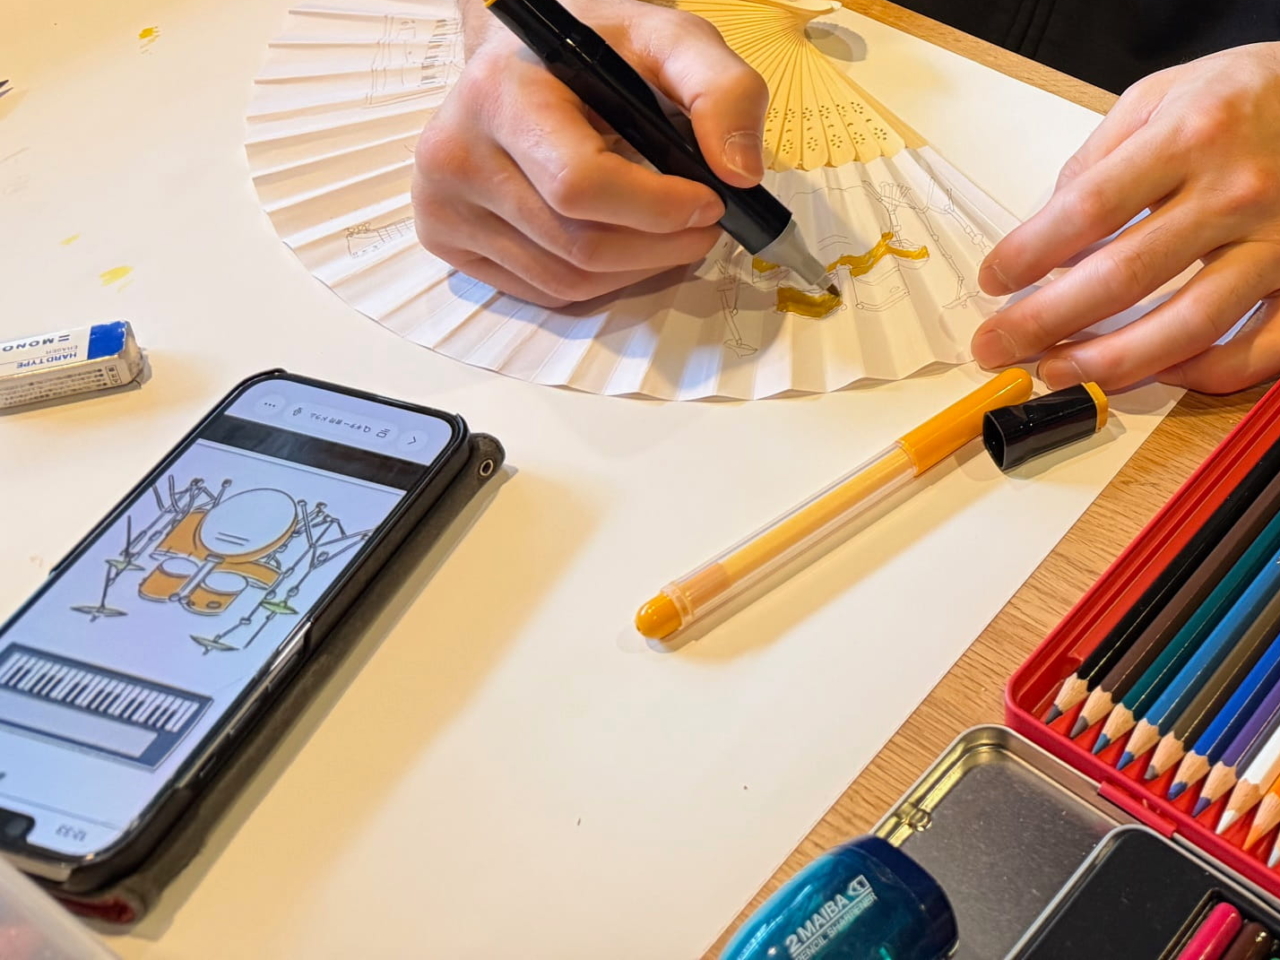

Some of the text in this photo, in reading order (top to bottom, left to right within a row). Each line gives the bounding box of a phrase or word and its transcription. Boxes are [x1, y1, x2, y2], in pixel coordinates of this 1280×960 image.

[2, 338, 55, 352] MONO
[16, 352, 77, 369] HARD TYPE
[827, 892, 878, 938] SHARPENER
